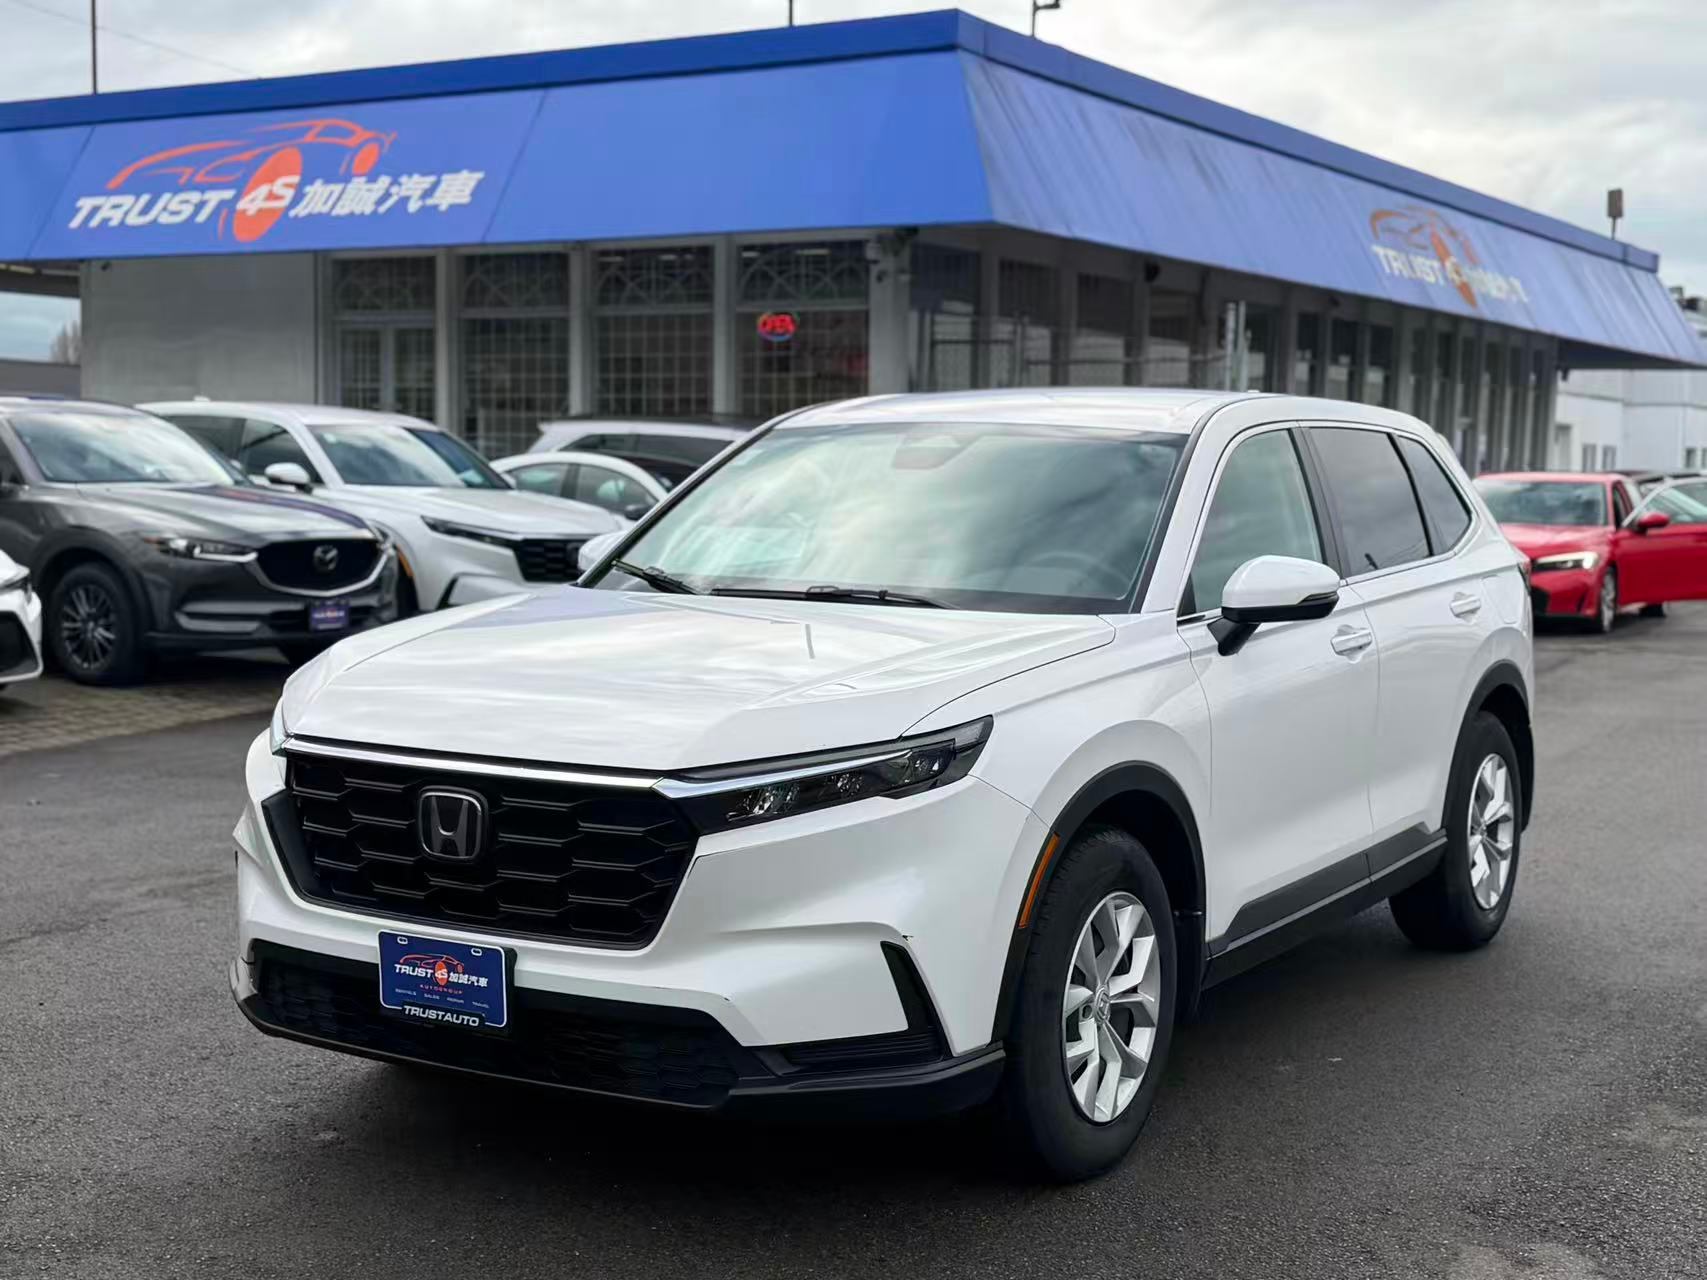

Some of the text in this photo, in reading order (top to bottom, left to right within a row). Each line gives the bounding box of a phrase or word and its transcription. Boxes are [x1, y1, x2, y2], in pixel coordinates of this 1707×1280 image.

[68, 170, 485, 229] TRUST 4S 加誠汽車
[394, 963, 434, 979] TRUST
[403, 1005, 479, 1027] TRUSTAUTO
